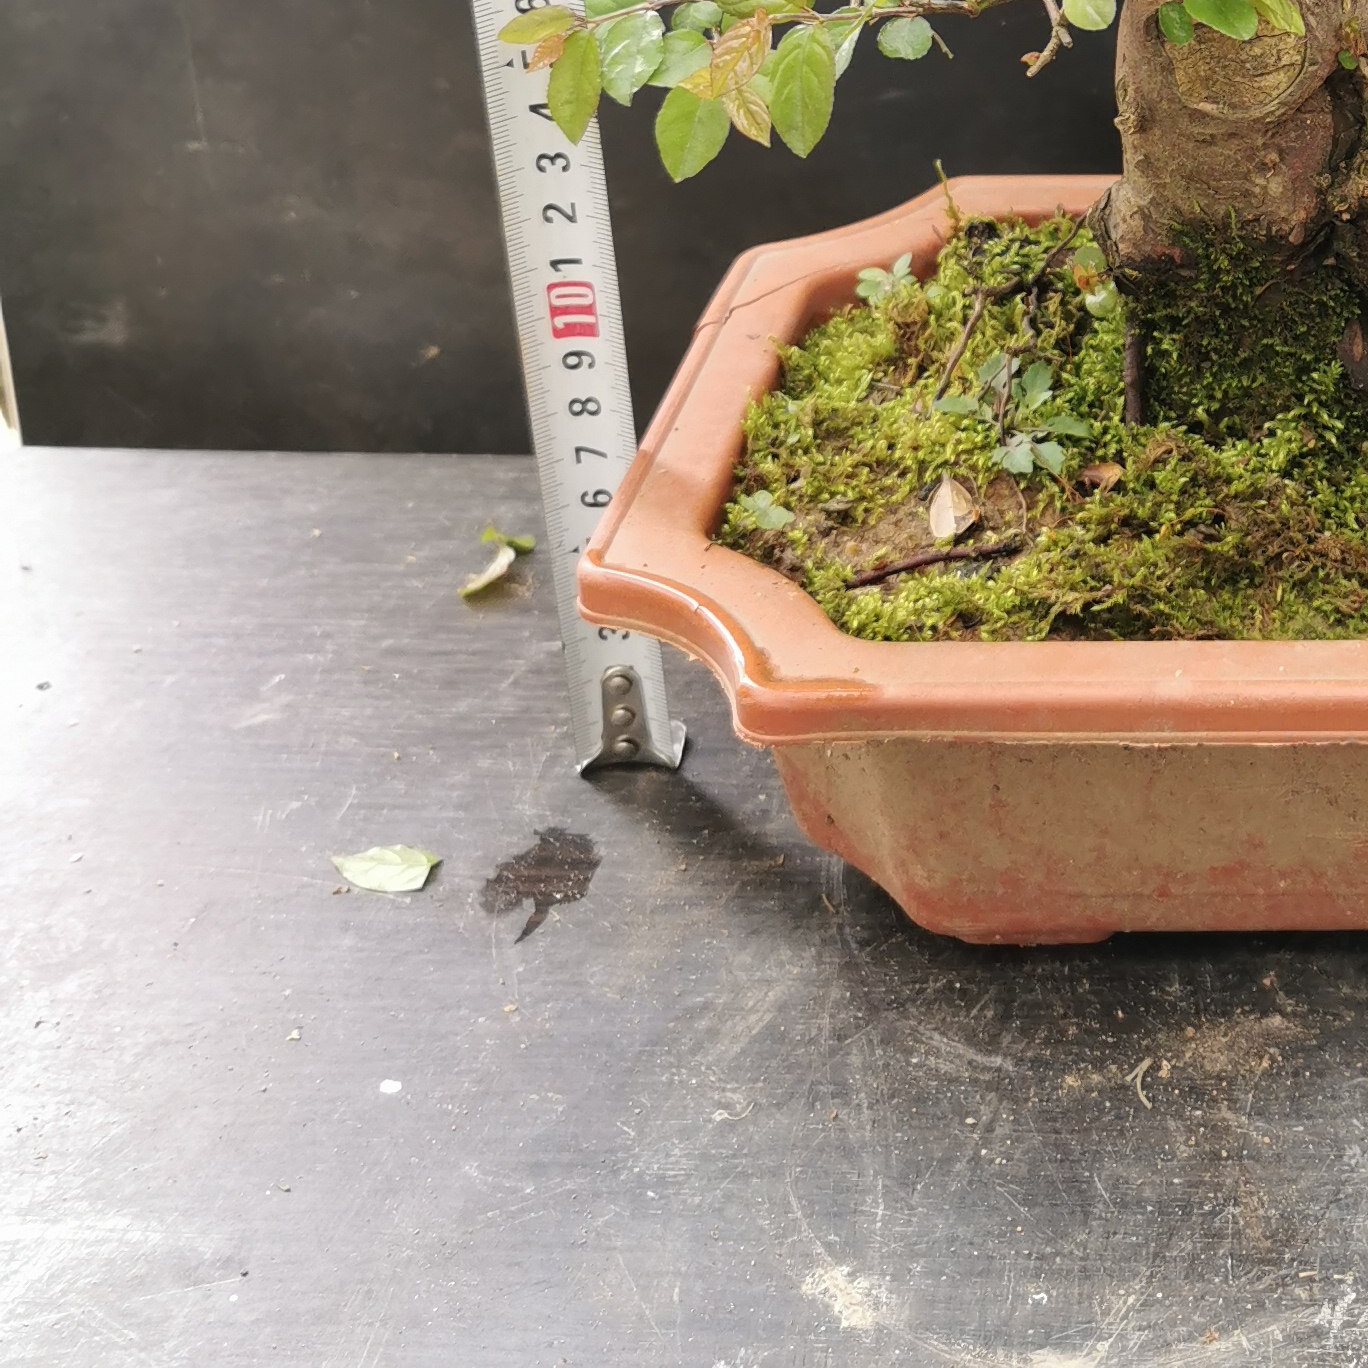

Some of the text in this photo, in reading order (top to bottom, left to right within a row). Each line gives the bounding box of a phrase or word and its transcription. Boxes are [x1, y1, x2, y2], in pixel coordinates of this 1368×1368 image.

[535, 152, 571, 173] 3
[542, 202, 577, 223] 2
[549, 257, 583, 272] 1
[551, 285, 597, 331] 10
[561, 349, 596, 370] 9
[568, 396, 601, 417] 8
[574, 445, 607, 464] 7
[580, 488, 613, 508] 6
